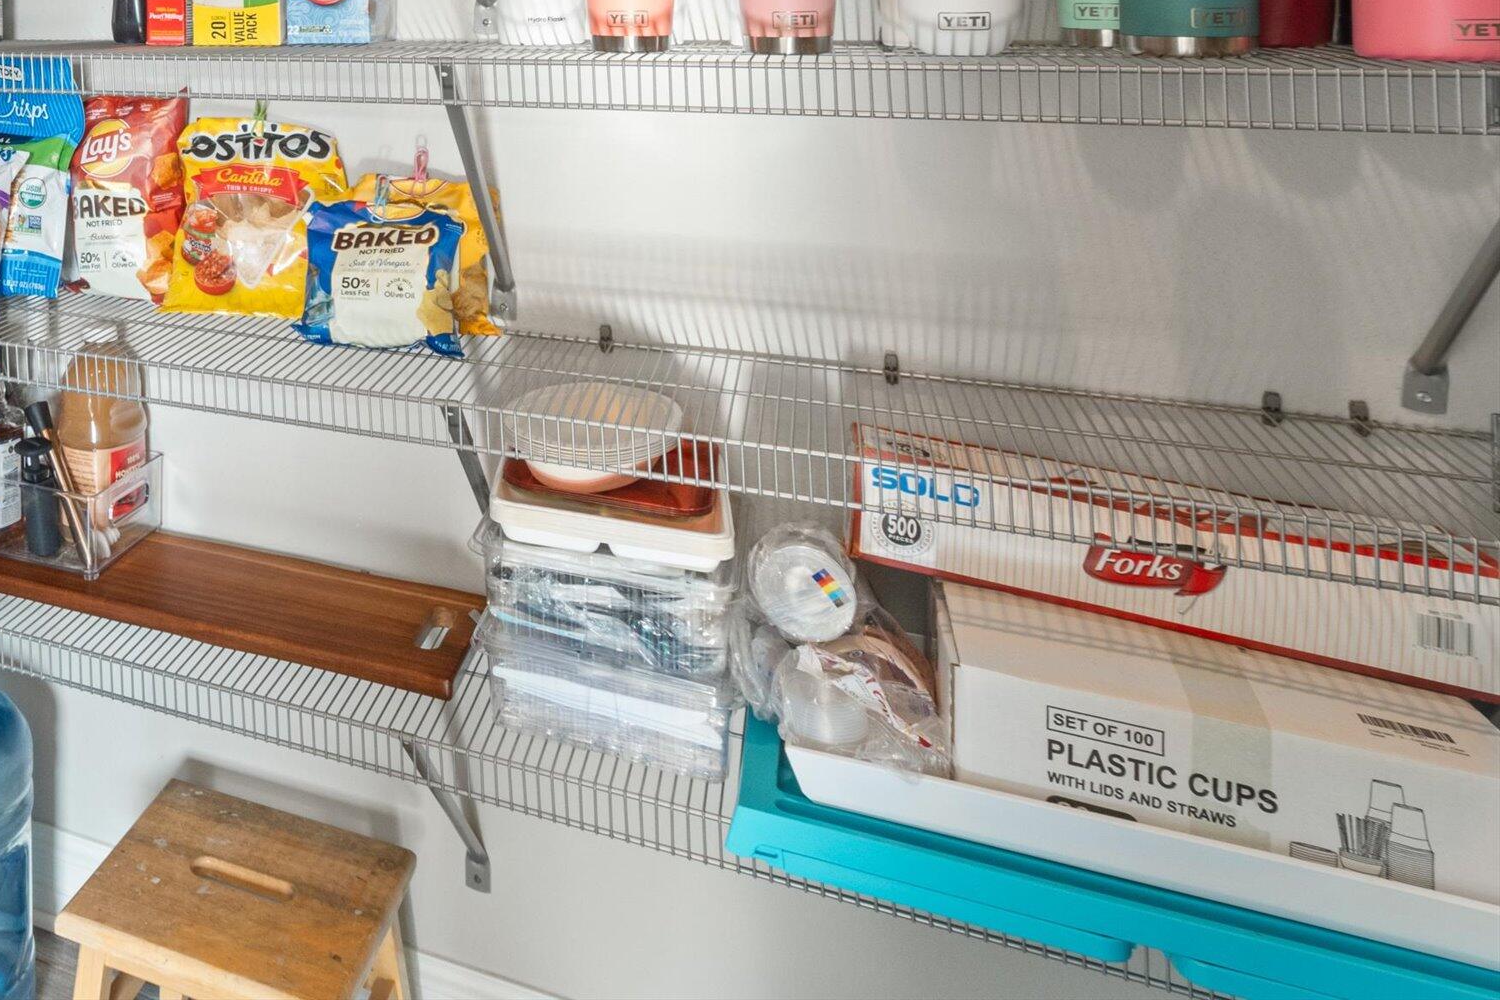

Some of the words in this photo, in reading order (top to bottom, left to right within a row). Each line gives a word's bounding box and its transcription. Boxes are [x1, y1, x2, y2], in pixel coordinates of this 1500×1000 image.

[607, 13, 647, 26] YETI
[1078, 5, 1118, 18] YETI
[233, 10, 246, 43] VALUE
[246, 12, 258, 40] PACK
[528, 15, 547, 25] Hydro
[775, 13, 815, 27] YETI
[942, 14, 988, 29] YETI
[211, 20, 227, 40] 20
[80, 128, 133, 165] Lay's
[216, 168, 283, 186] Cantina
[334, 228, 436, 251] BAKED
[80, 252, 100, 264] 50%
[359, 248, 378, 256] NOT
[380, 247, 405, 255] FRIED
[111, 261, 127, 269] Olive
[349, 259, 366, 268] Salt
[374, 258, 412, 269] Vinegar
[341, 276, 371, 289] 50%
[340, 289, 356, 297] Less
[357, 289, 370, 297] Fat
[404, 291, 415, 299] Oil
[871, 466, 981, 510] SOLO
[886, 518, 918, 539] 500
[1094, 547, 1184, 581] Forks
[1053, 712, 1088, 732] SET
[1092, 722, 1118, 739] OF
[1124, 729, 1155, 747] 100
[1047, 738, 1178, 790] PLASTIC
[1188, 772, 1279, 815] CUPS
[1047, 770, 1086, 791] WITH
[1090, 780, 1125, 801] LIDS
[1128, 790, 1163, 810] AND
[1166, 799, 1238, 829] STRAWS
